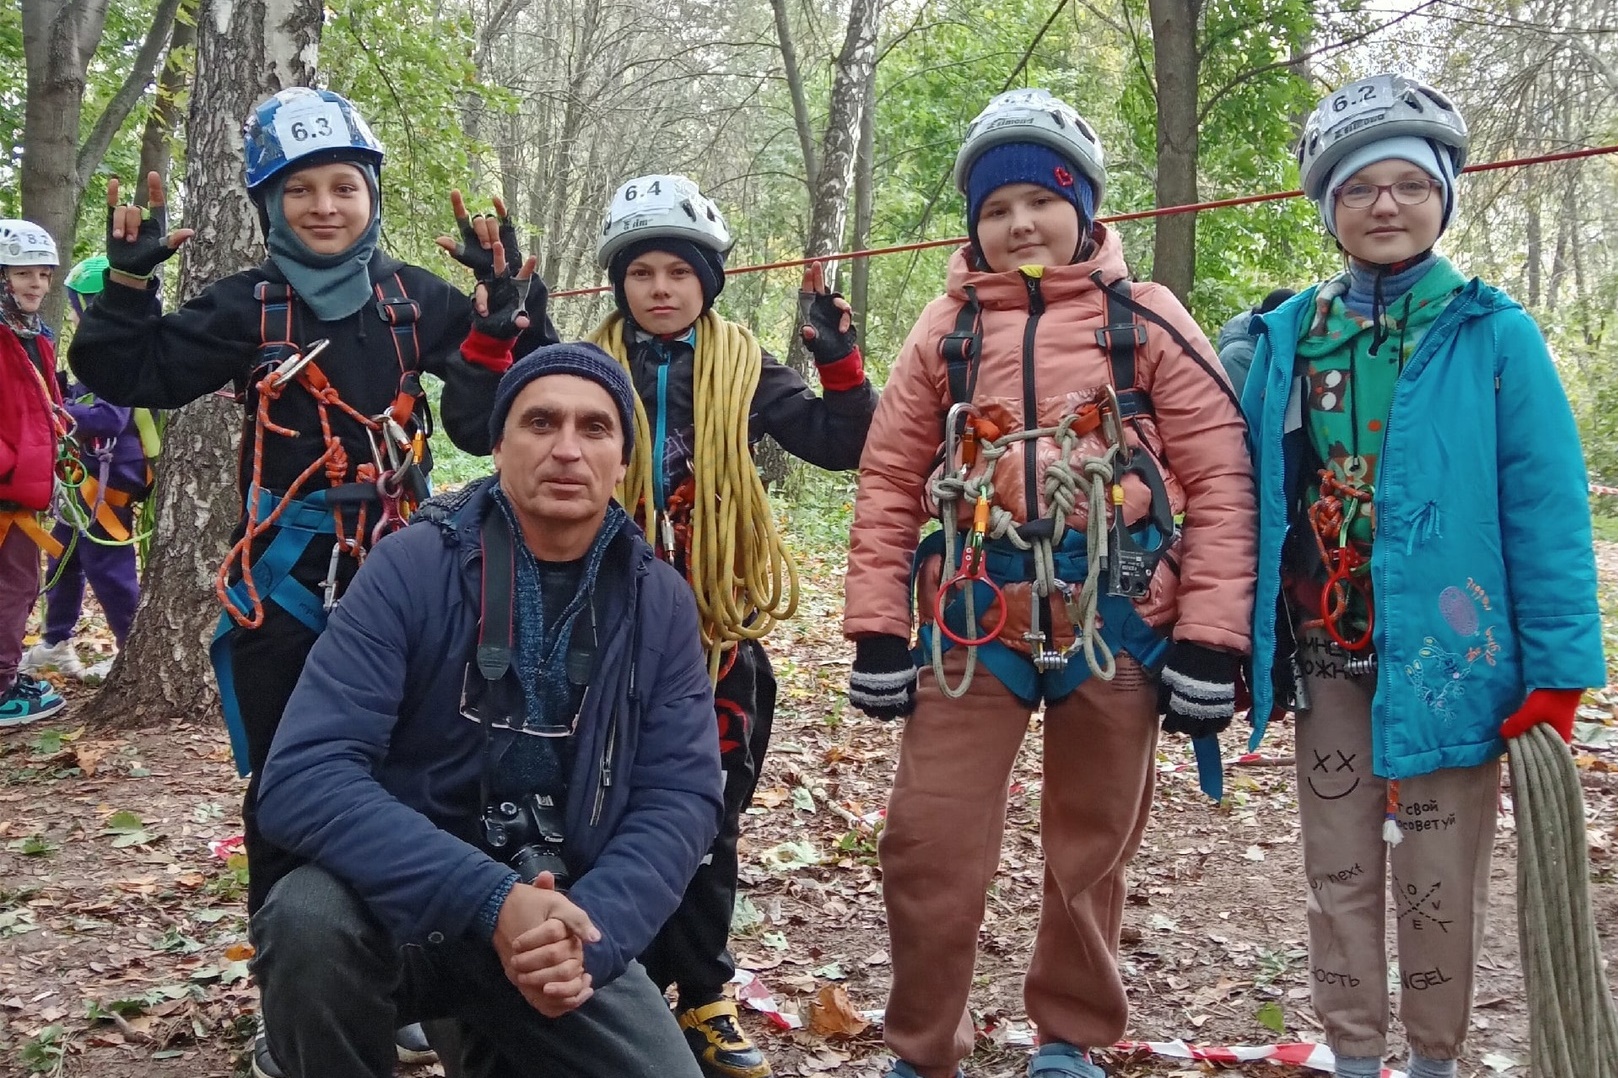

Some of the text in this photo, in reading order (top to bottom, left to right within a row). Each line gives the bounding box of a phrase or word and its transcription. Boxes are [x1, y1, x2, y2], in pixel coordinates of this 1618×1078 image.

[1333, 85, 1377, 113] 6.2
[291, 117, 333, 142] 6.3
[625, 180, 662, 201] 6.4
